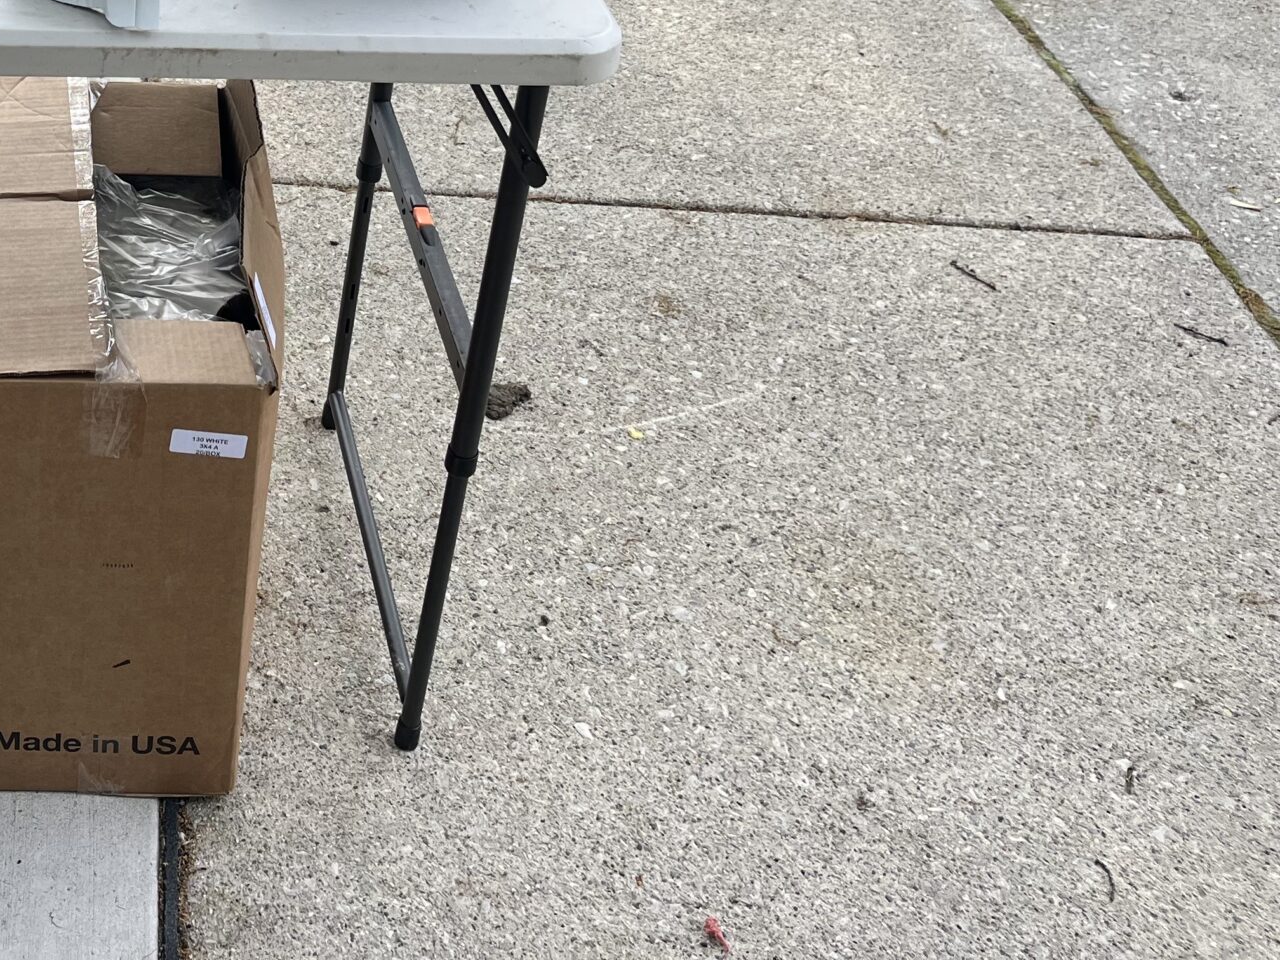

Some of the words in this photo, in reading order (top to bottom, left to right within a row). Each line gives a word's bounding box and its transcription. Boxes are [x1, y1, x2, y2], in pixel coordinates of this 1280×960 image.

[205, 437, 229, 445] WHITE
[92, 734, 119, 753] in
[131, 735, 200, 755] USA
